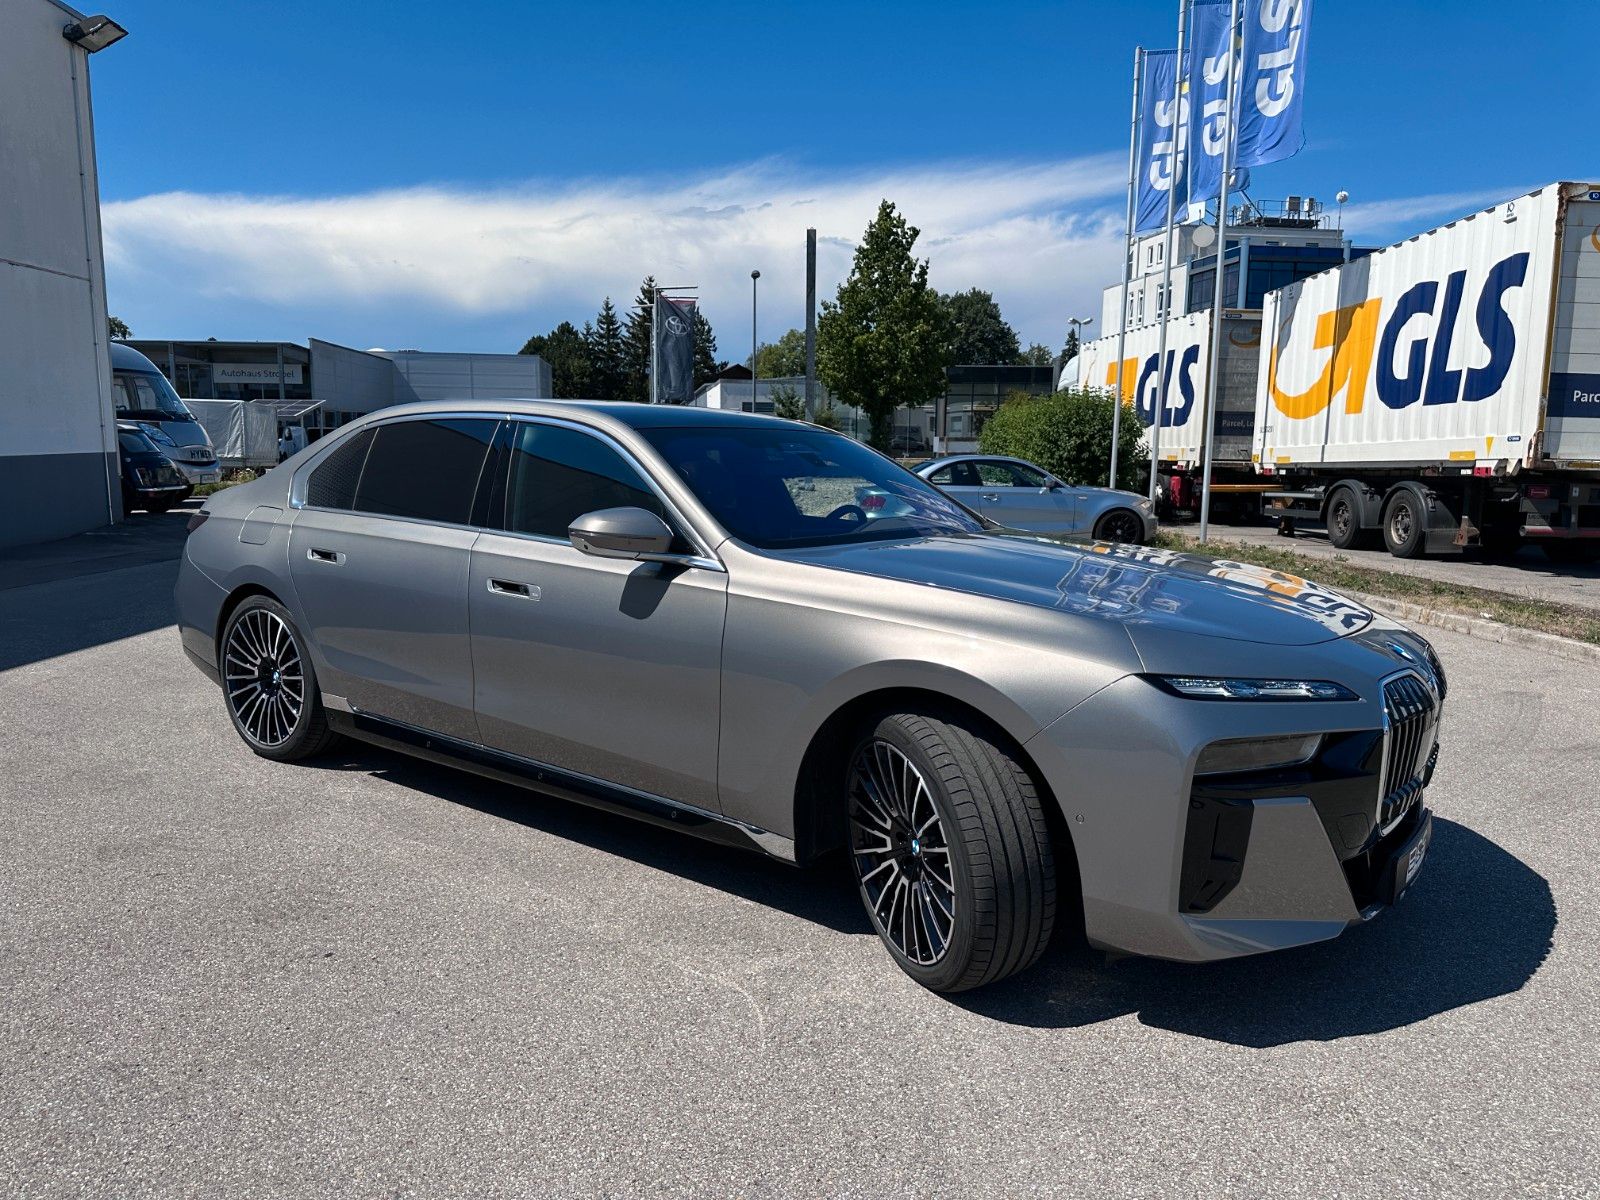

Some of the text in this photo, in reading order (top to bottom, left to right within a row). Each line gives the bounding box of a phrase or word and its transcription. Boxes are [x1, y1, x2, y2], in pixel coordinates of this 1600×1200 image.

[1203, 51, 1240, 156] GLS
[1256, 0, 1301, 117] GLS
[1150, 97, 1189, 191] GLS
[221, 369, 261, 378] Autohaus
[1375, 252, 1530, 409] GLS
[1136, 344, 1200, 428] GLS
